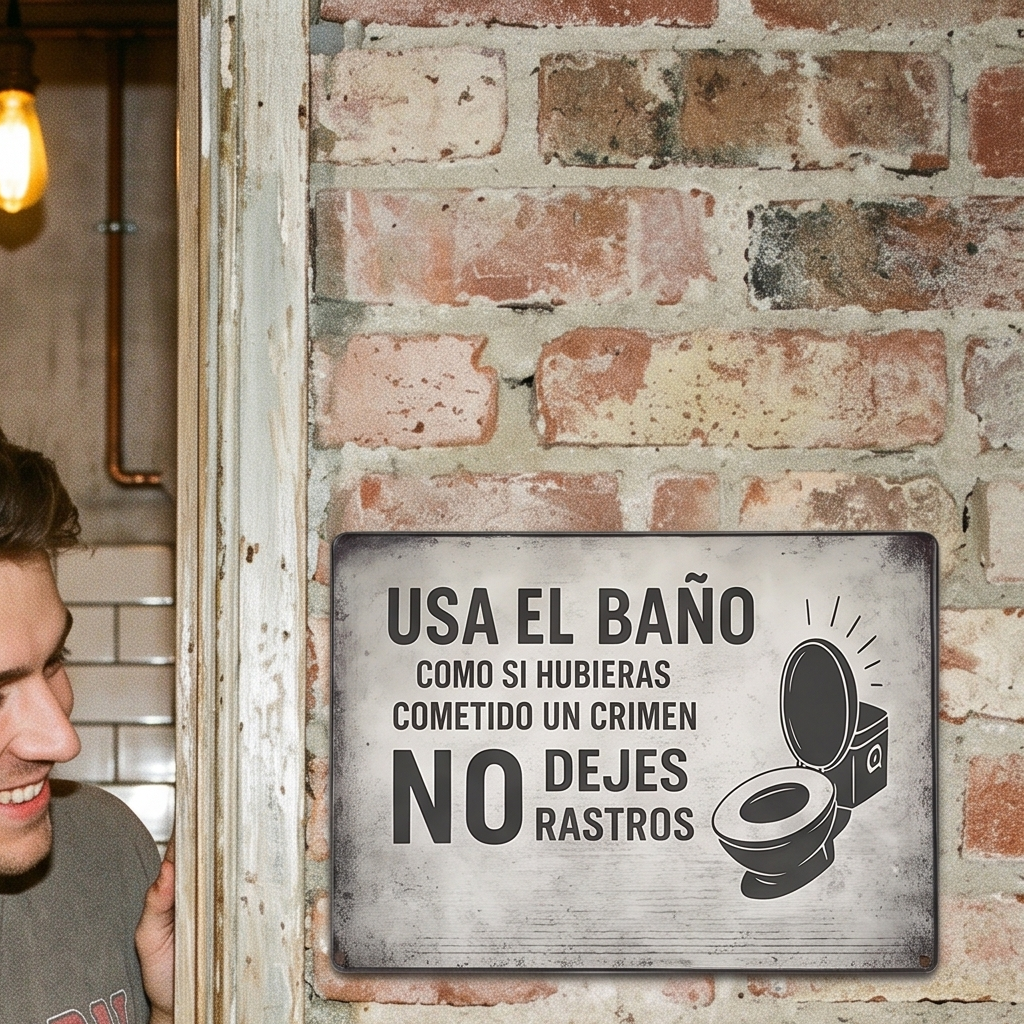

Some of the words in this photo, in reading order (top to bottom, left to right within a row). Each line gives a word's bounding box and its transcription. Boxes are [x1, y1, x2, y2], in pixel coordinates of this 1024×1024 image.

[387, 586, 499, 646] USA
[517, 587, 574, 645] EL
[598, 572, 755, 646] BAÑO
[416, 660, 493, 689] COMO
[502, 660, 526, 689] SI
[537, 660, 671, 689] HUBIERAS
[392, 701, 533, 731] COMETIDO
[543, 701, 580, 731] UN
[590, 701, 697, 731] CRIMEN
[392, 748, 523, 846] NO
[545, 748, 688, 793] DEJES
[535, 807, 695, 842] RASTROS
